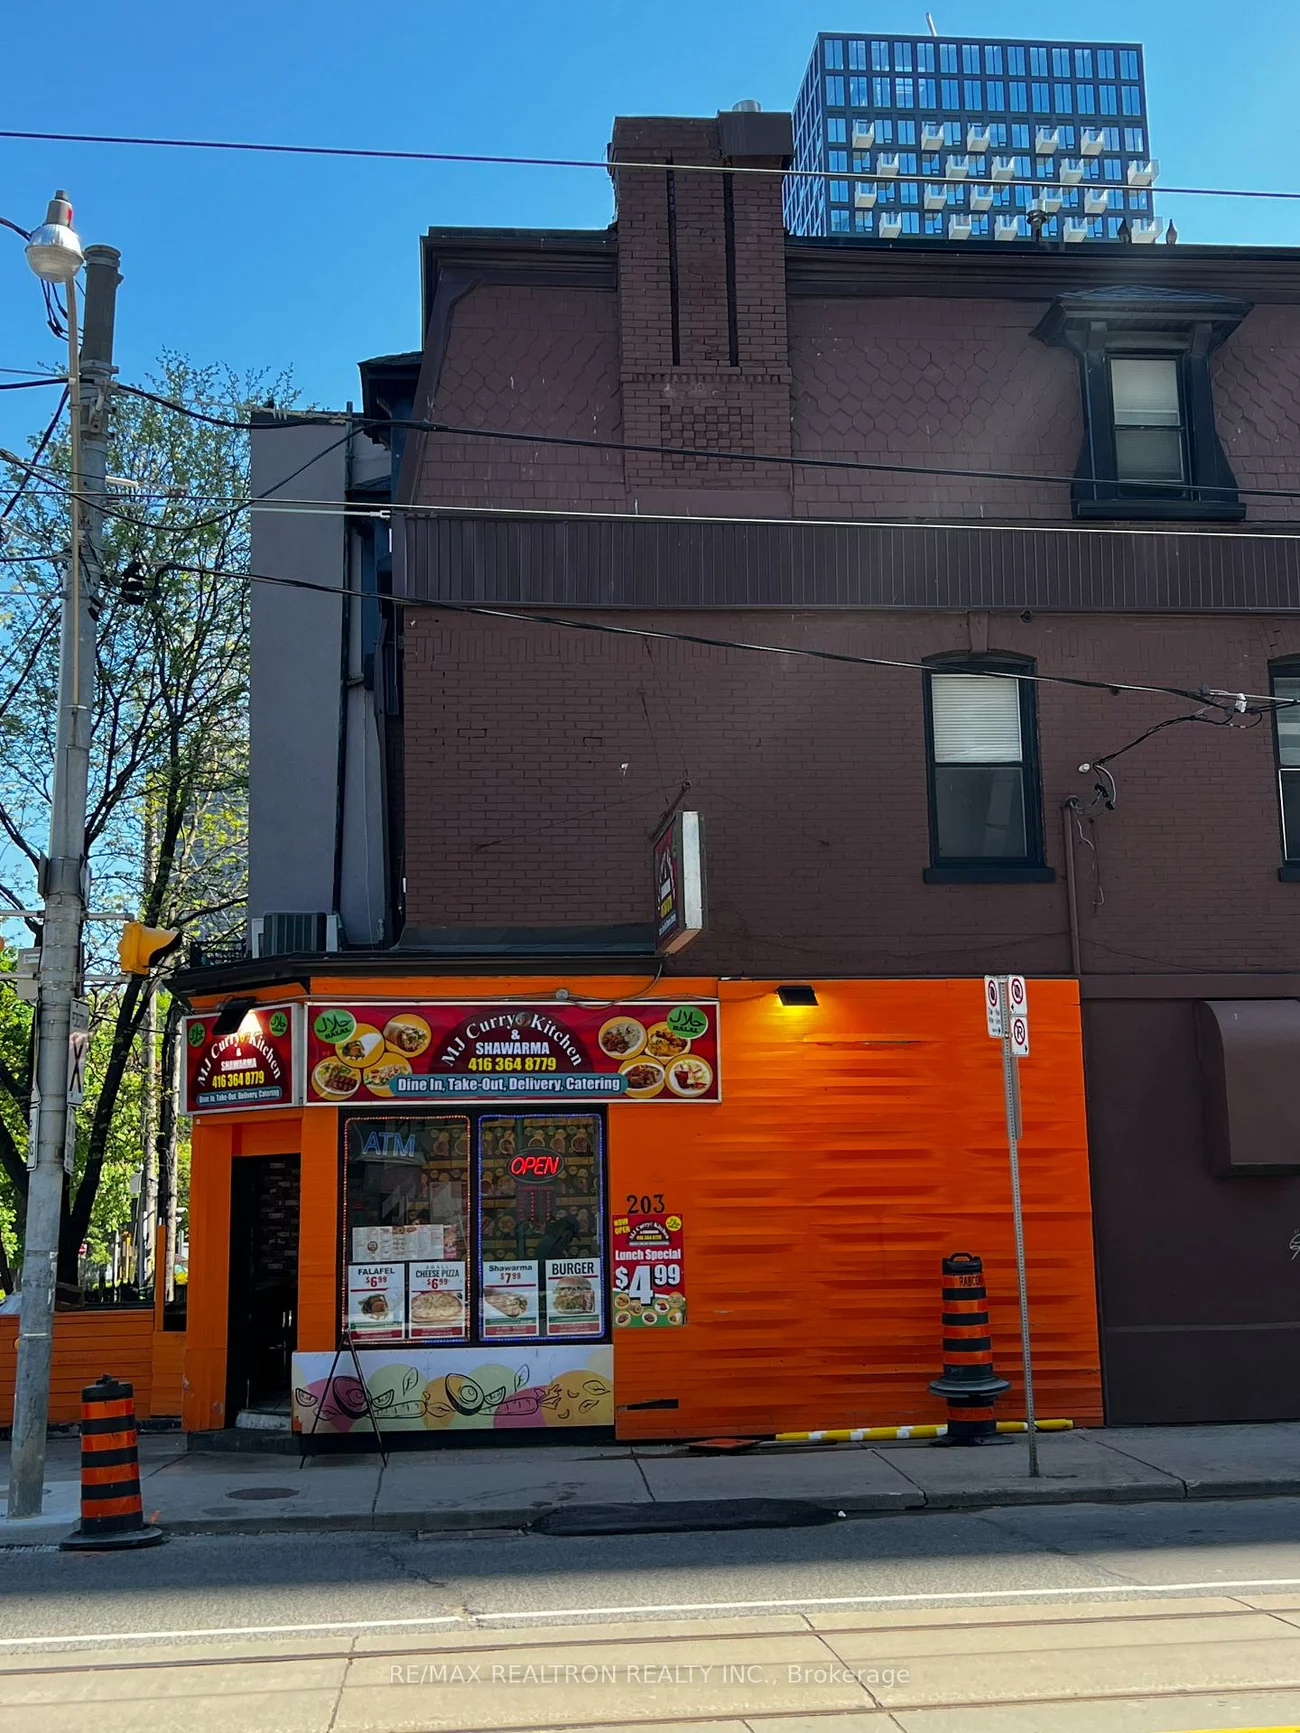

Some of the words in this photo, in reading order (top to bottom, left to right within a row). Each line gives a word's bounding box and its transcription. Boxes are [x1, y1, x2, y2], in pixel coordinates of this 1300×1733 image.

[441, 1036, 466, 1067] MJ
[466, 1014, 517, 1039] Curry
[530, 1014, 583, 1066] Kitchen
[511, 1029, 520, 1040] &
[475, 1042, 550, 1055] SHAWARMA
[198, 1057, 212, 1086] MJ
[211, 1033, 239, 1059] Curry
[249, 1032, 281, 1079] Kitchen
[221, 1058, 257, 1071] SHAWARMA
[468, 1057, 492, 1071] 416
[495, 1057, 522, 1071] 364
[525, 1057, 557, 1071] 8779
[212, 1074, 226, 1088] 416
[228, 1072, 243, 1087] 364
[245, 1070, 265, 1085] 8779
[398, 1078, 427, 1091] Dine
[429, 1078, 445, 1092] In,
[448, 1078, 506, 1092] Take-Out,
[509, 1078, 564, 1092] Delivery,
[566, 1077, 620, 1092] Catering
[362, 1131, 416, 1157] ATM
[510, 1156, 560, 1176] OPEN
[626, 1194, 665, 1214] 203
[615, 1250, 644, 1260] Lunch
[645, 1249, 681, 1261] Special
[415, 1270, 439, 1278] CHEESE
[552, 1262, 594, 1275] BURGER
